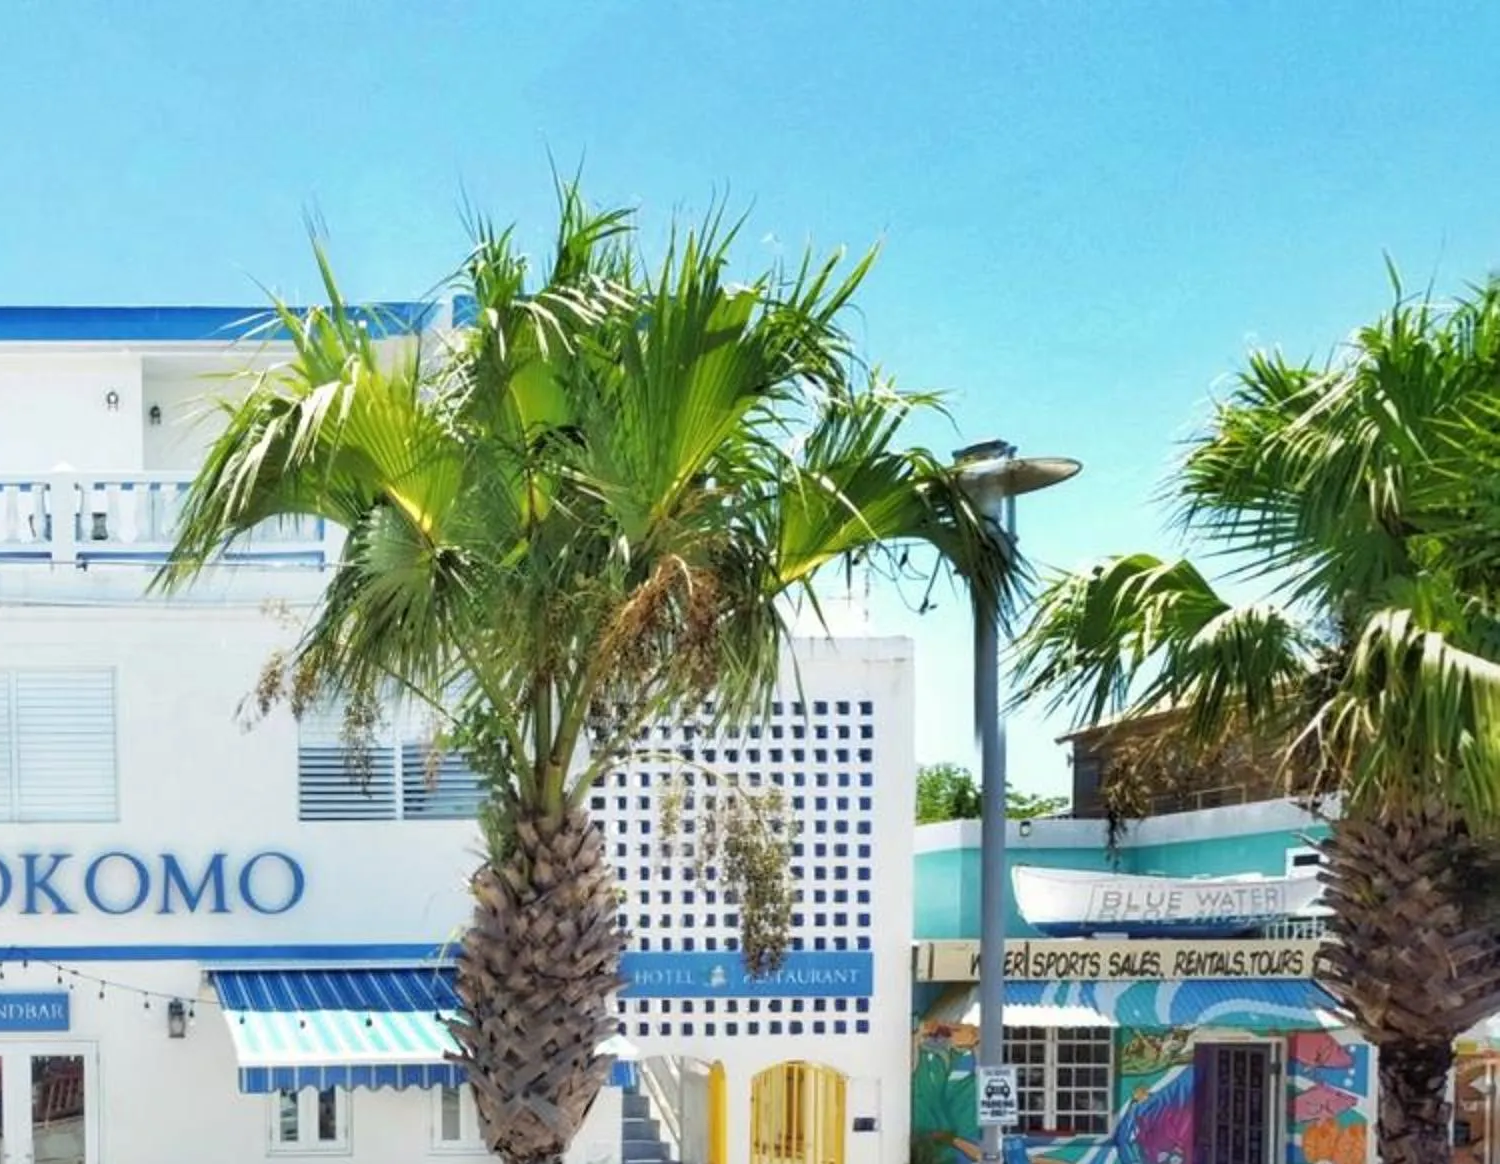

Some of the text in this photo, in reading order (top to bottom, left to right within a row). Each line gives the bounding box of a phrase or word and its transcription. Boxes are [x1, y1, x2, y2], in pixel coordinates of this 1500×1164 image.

[1102, 884, 1279, 912] BLUE WATER
[634, 969, 695, 985] HOTEL
[1032, 951, 1100, 978] SPORTS
[1250, 949, 1304, 976] TOURS
